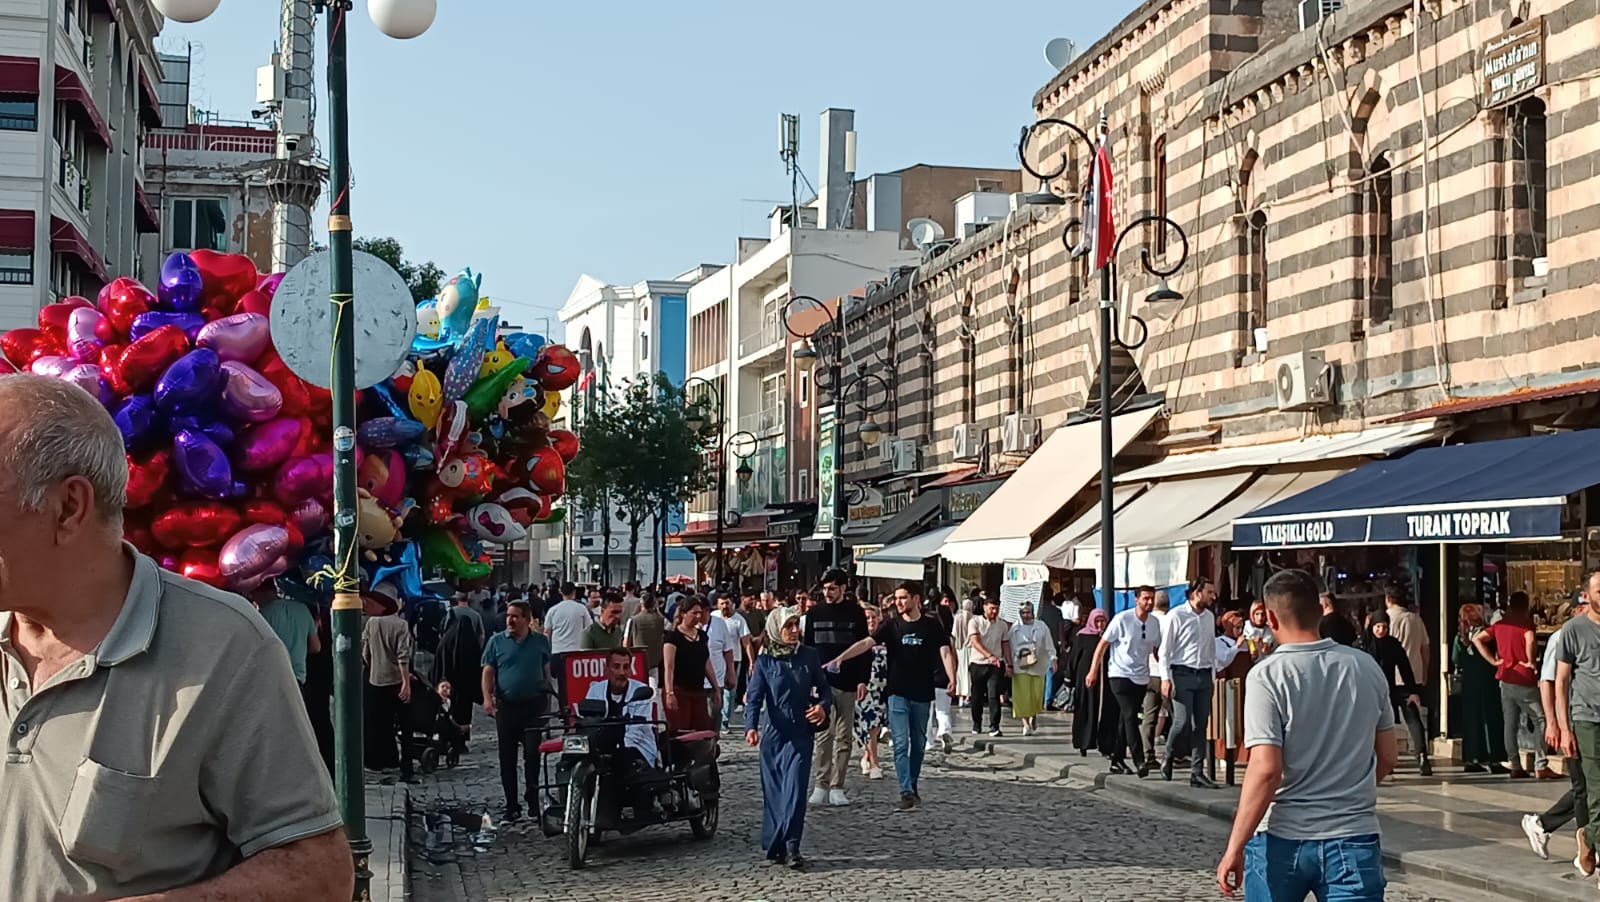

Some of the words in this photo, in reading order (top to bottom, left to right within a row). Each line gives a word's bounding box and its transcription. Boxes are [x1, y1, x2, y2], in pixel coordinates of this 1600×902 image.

[1261, 523, 1305, 545] YAKIŞIKLI
[1306, 521, 1333, 542] GOLD
[1407, 513, 1451, 537] TURAN
[1453, 511, 1510, 535] TOPRAK
